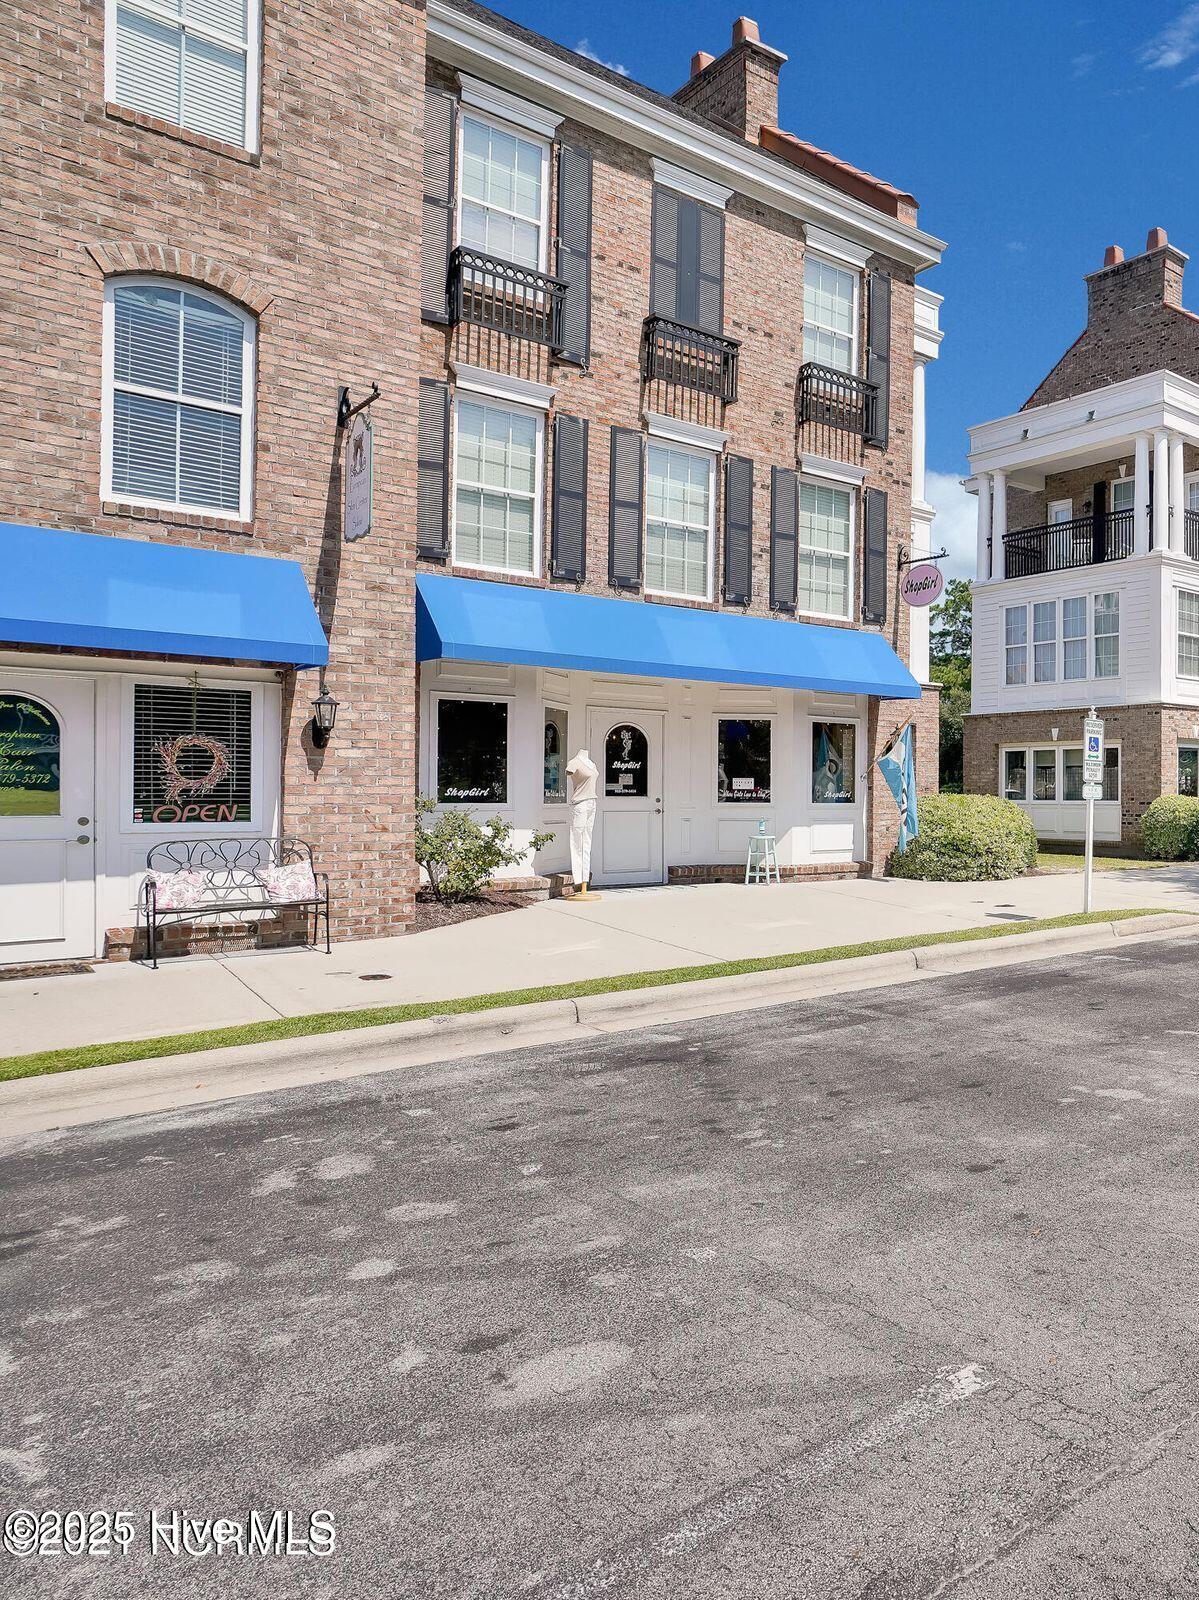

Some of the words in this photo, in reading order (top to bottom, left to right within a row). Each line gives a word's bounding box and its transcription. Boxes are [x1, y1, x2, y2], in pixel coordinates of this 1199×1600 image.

[904, 574, 939, 596] ShopGirl
[611, 761, 641, 771] ShopGirl
[0, 773, 51, 784] 79-5372
[444, 787, 490, 799] ShopGirl
[823, 790, 852, 799] ShopGirl
[152, 804, 238, 823] OPEN
